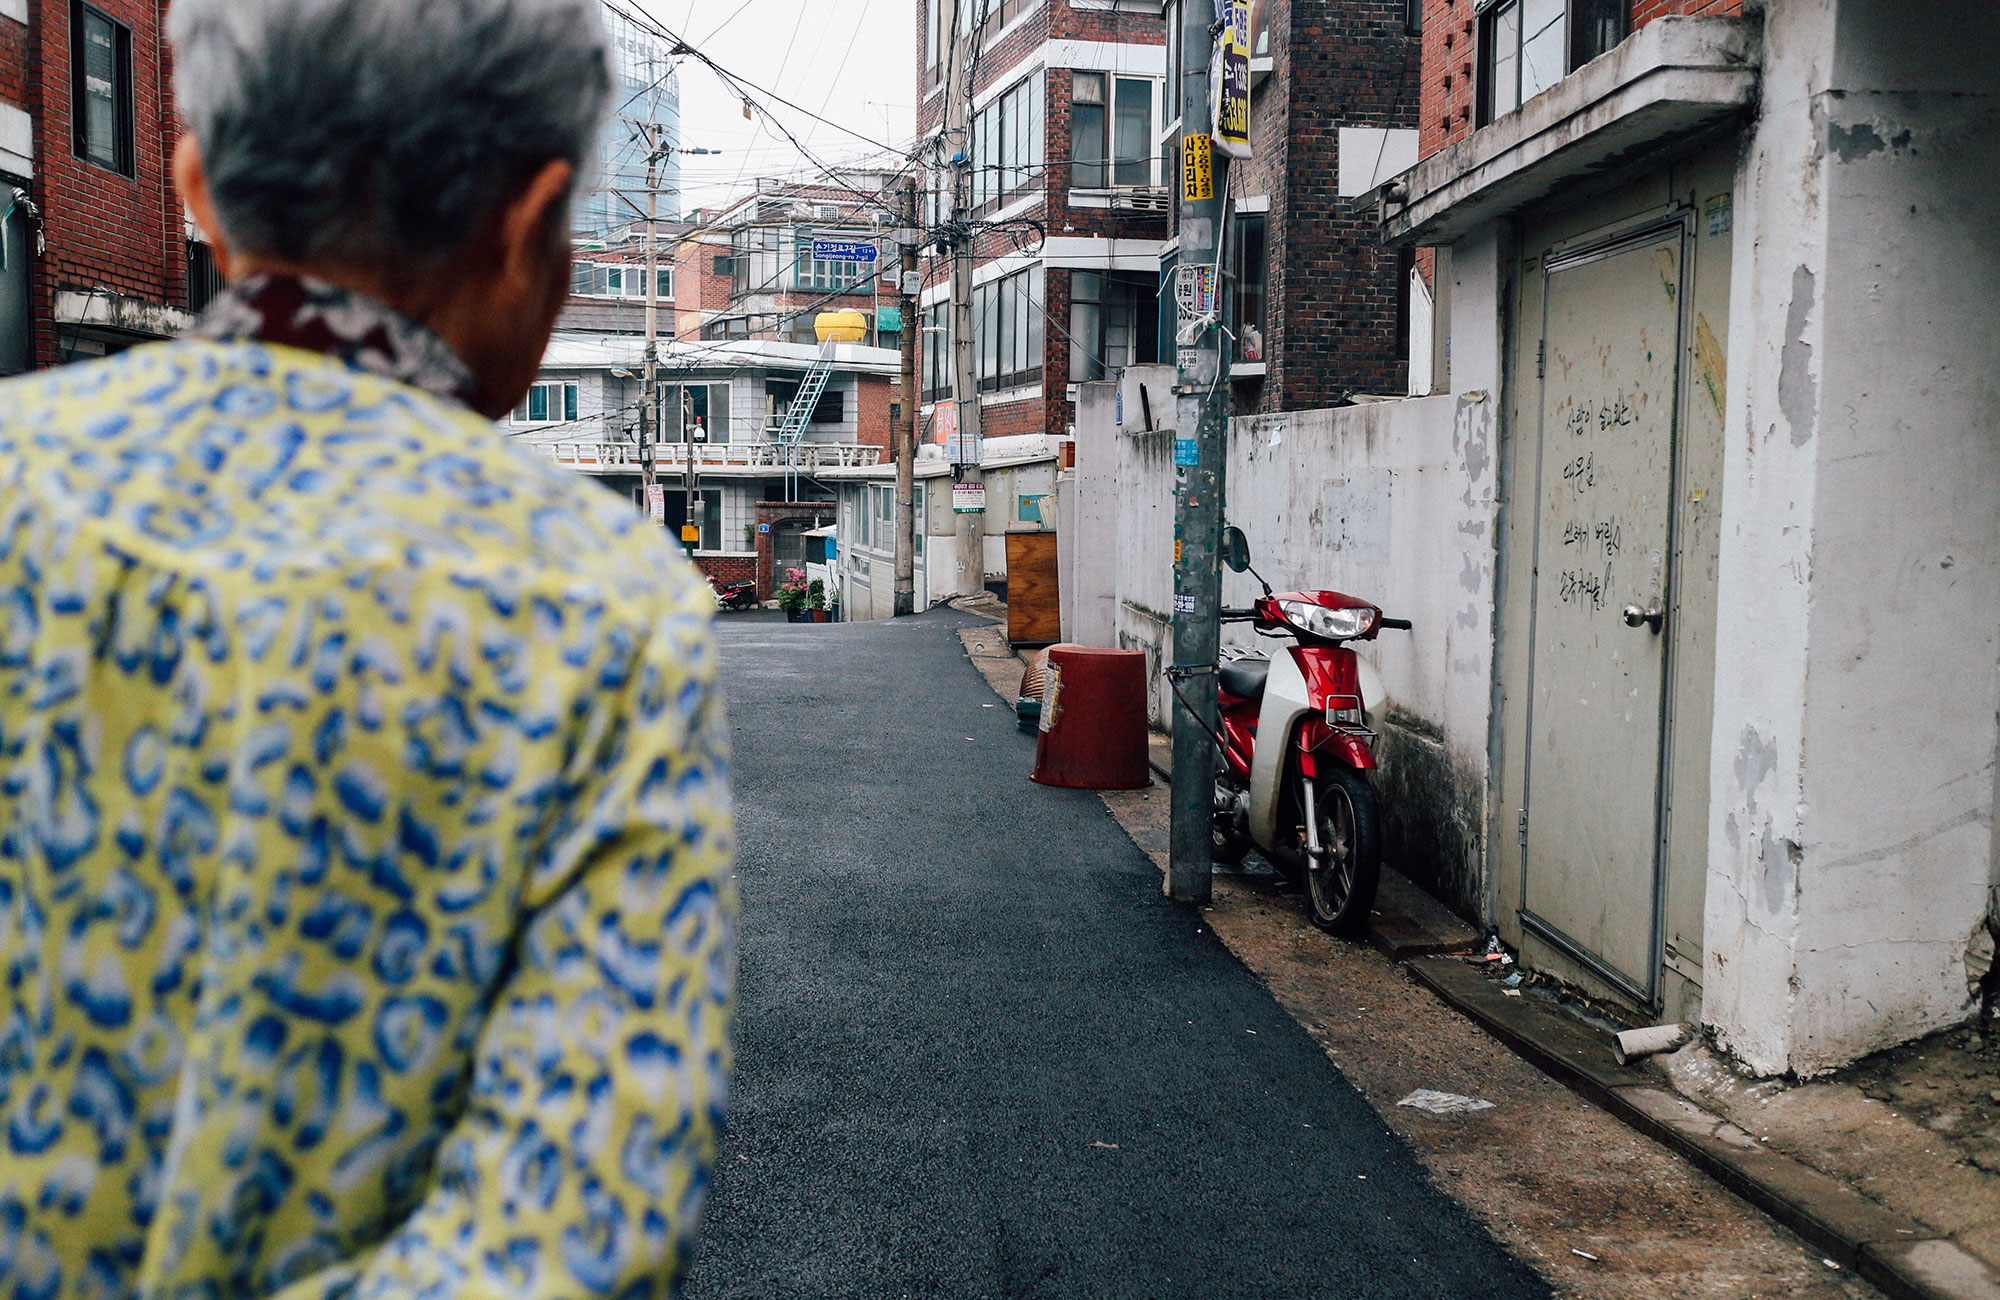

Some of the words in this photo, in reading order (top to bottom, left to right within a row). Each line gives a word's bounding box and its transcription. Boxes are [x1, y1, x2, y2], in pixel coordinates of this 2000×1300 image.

[1185, 137, 1198, 197] 사다리차
[815, 243, 857, 254] 손기정로7길
[1565, 400, 1593, 440] 사람이
[1563, 521, 1589, 556] 쓰레기
[1594, 515, 1620, 560] 버릴시
